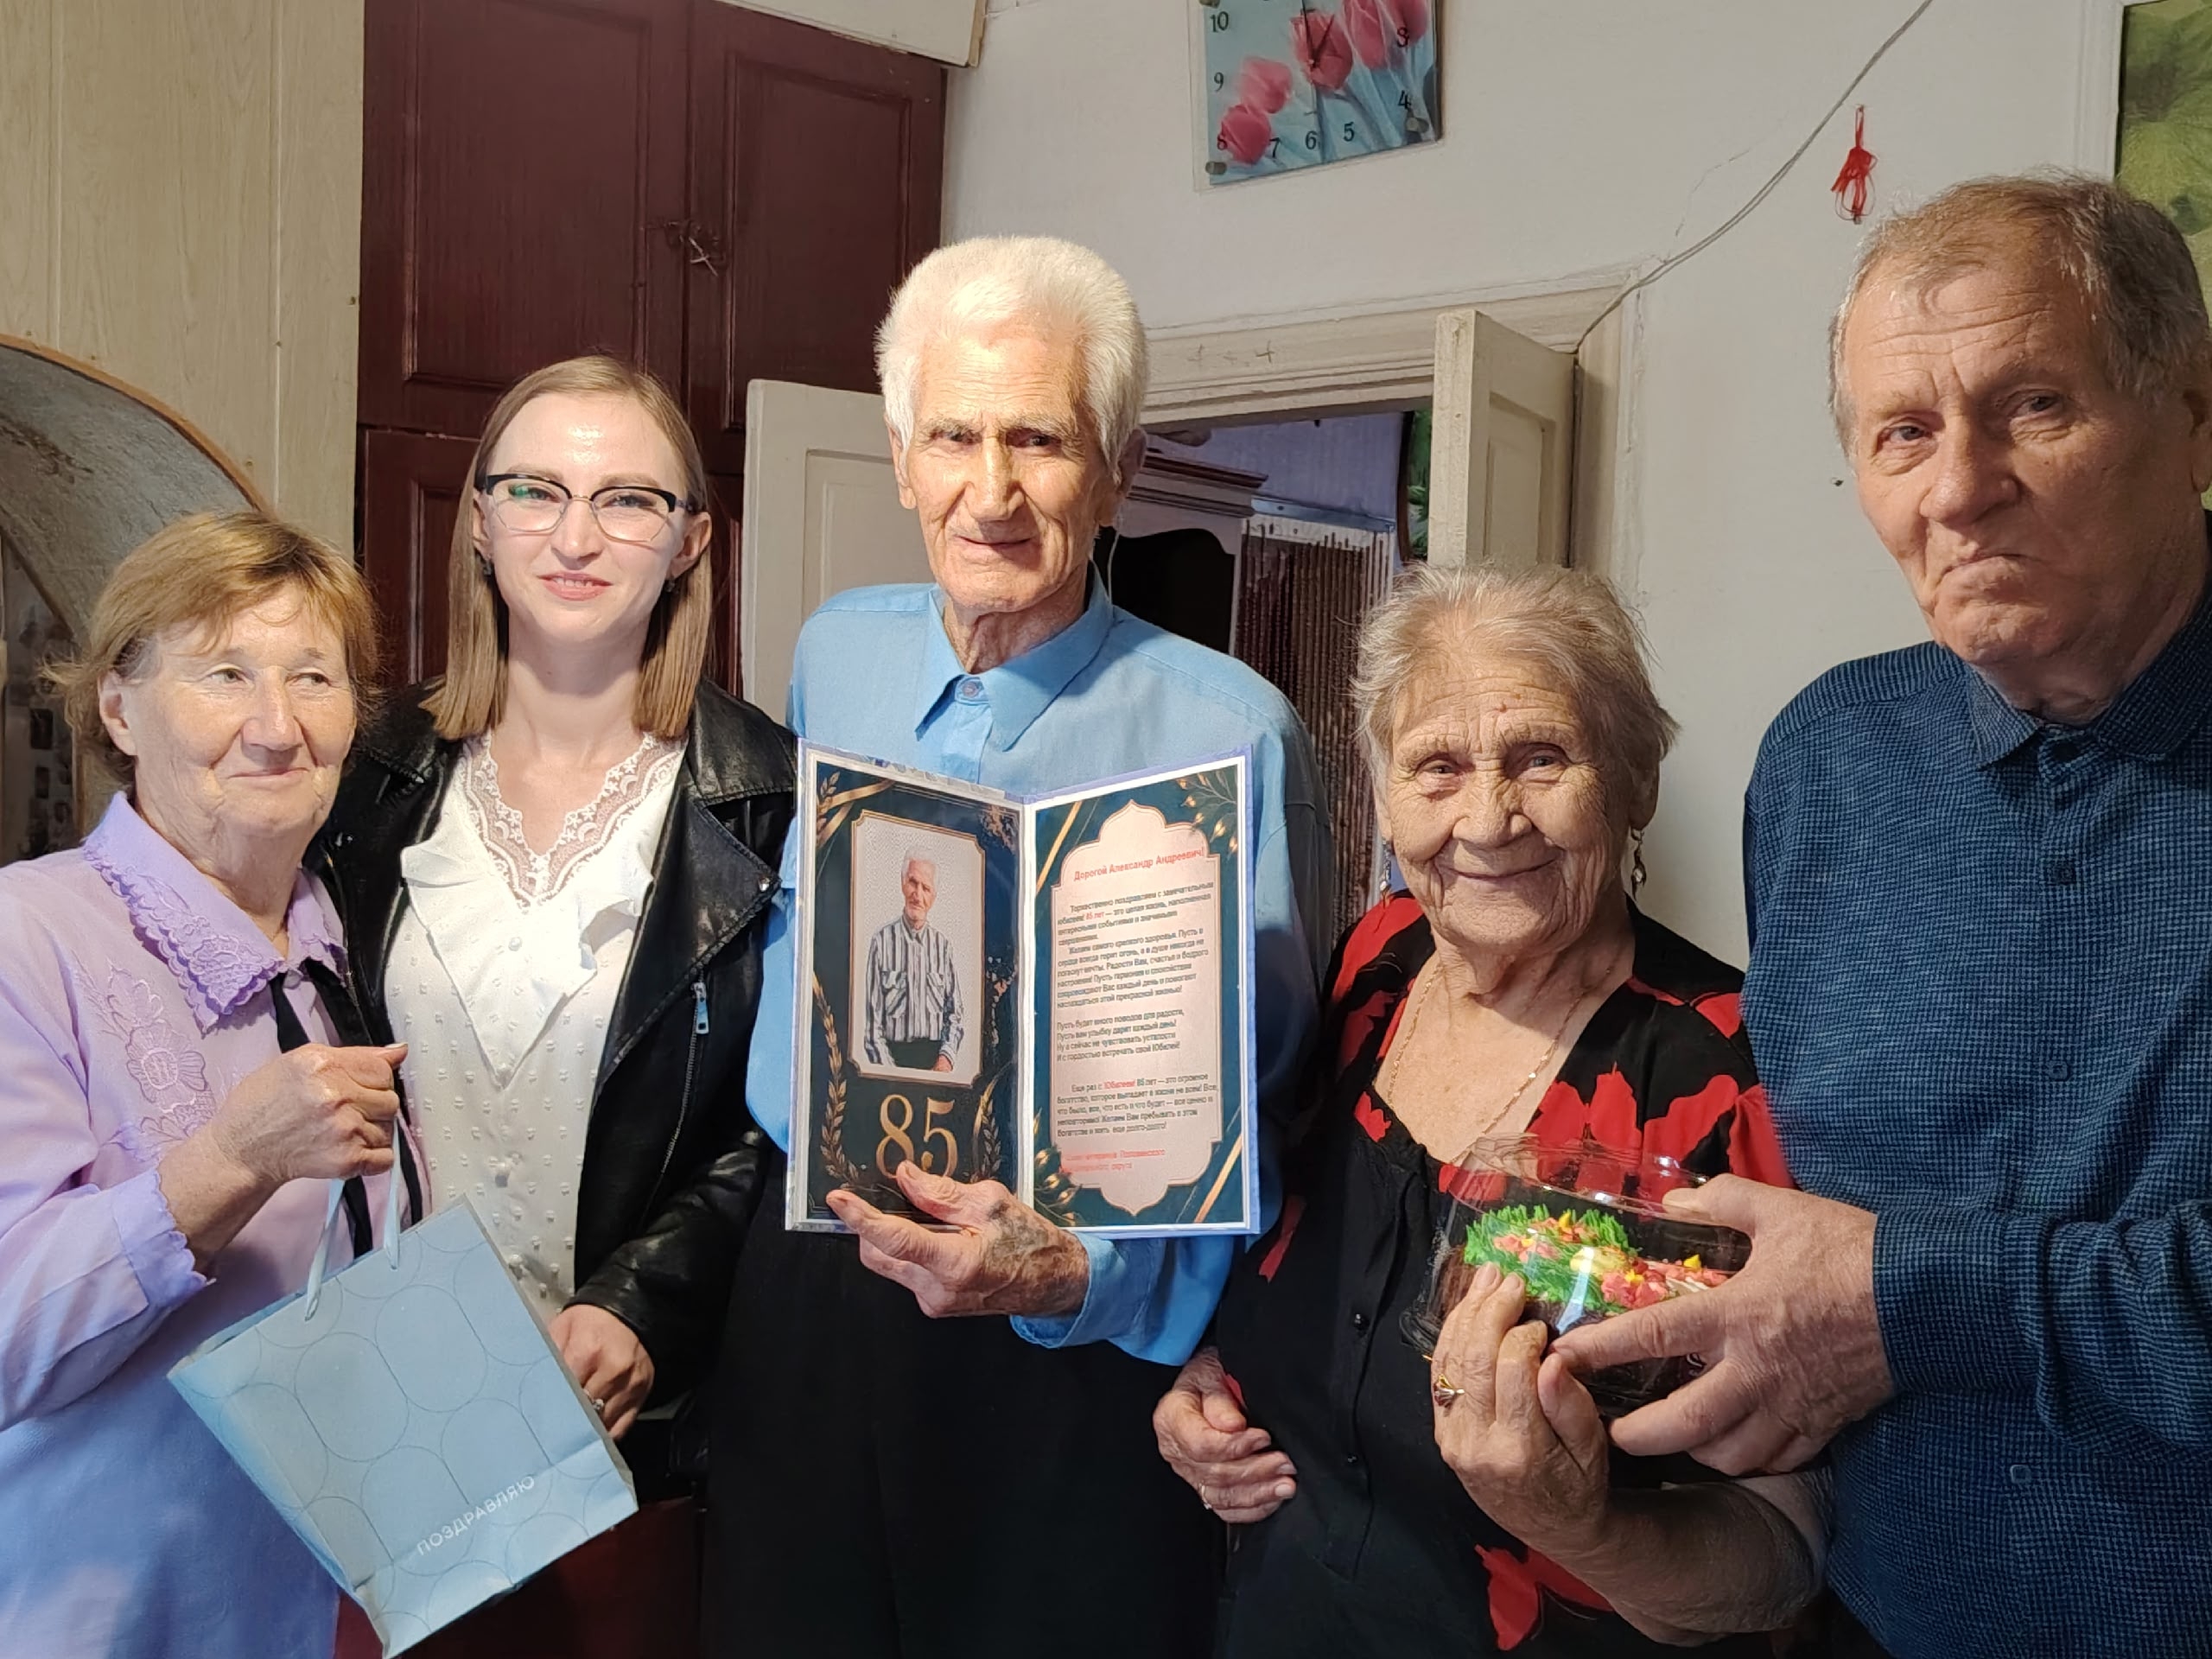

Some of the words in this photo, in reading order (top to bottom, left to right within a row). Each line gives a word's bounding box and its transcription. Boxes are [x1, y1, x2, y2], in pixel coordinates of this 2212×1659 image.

[1211, 11, 1229, 33] 10
[1396, 26, 1409, 48] 3
[1213, 72, 1224, 92] 9
[1397, 90, 1411, 110] 4
[1305, 130, 1319, 149] 6
[1344, 122, 1355, 142] 5
[1269, 137, 1281, 158] 7
[1074, 865, 1107, 881] Дорогой
[1109, 859, 1154, 874] Александр
[875, 1093, 958, 1179] 85
[416, 1476, 535, 1555] ПОЗДРАВЛЯЮ
